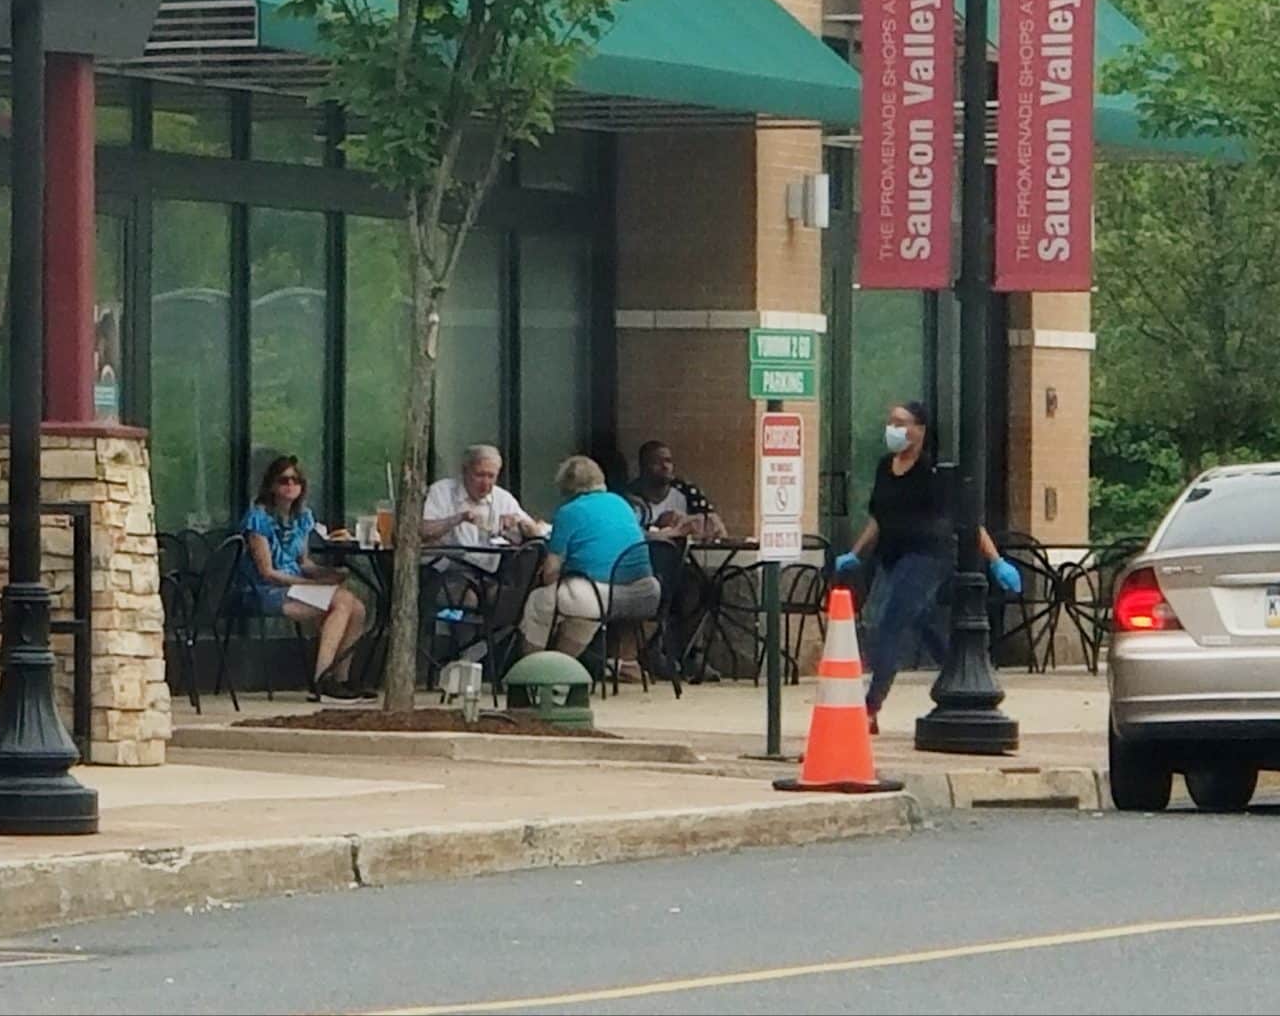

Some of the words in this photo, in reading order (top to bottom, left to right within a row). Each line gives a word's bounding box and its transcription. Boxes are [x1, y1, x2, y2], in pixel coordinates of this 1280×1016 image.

[882, 18, 897, 85] SHOPS
[1019, 18, 1034, 86] SHOPS
[880, 90, 897, 217] PROMENADE
[1017, 90, 1033, 217] PROMENADE
[900, 119, 934, 261] Saucon
[1037, 118, 1071, 262] Saucon
[879, 222, 895, 261] THE
[1016, 221, 1031, 262] THE
[763, 371, 804, 394] PARKING
